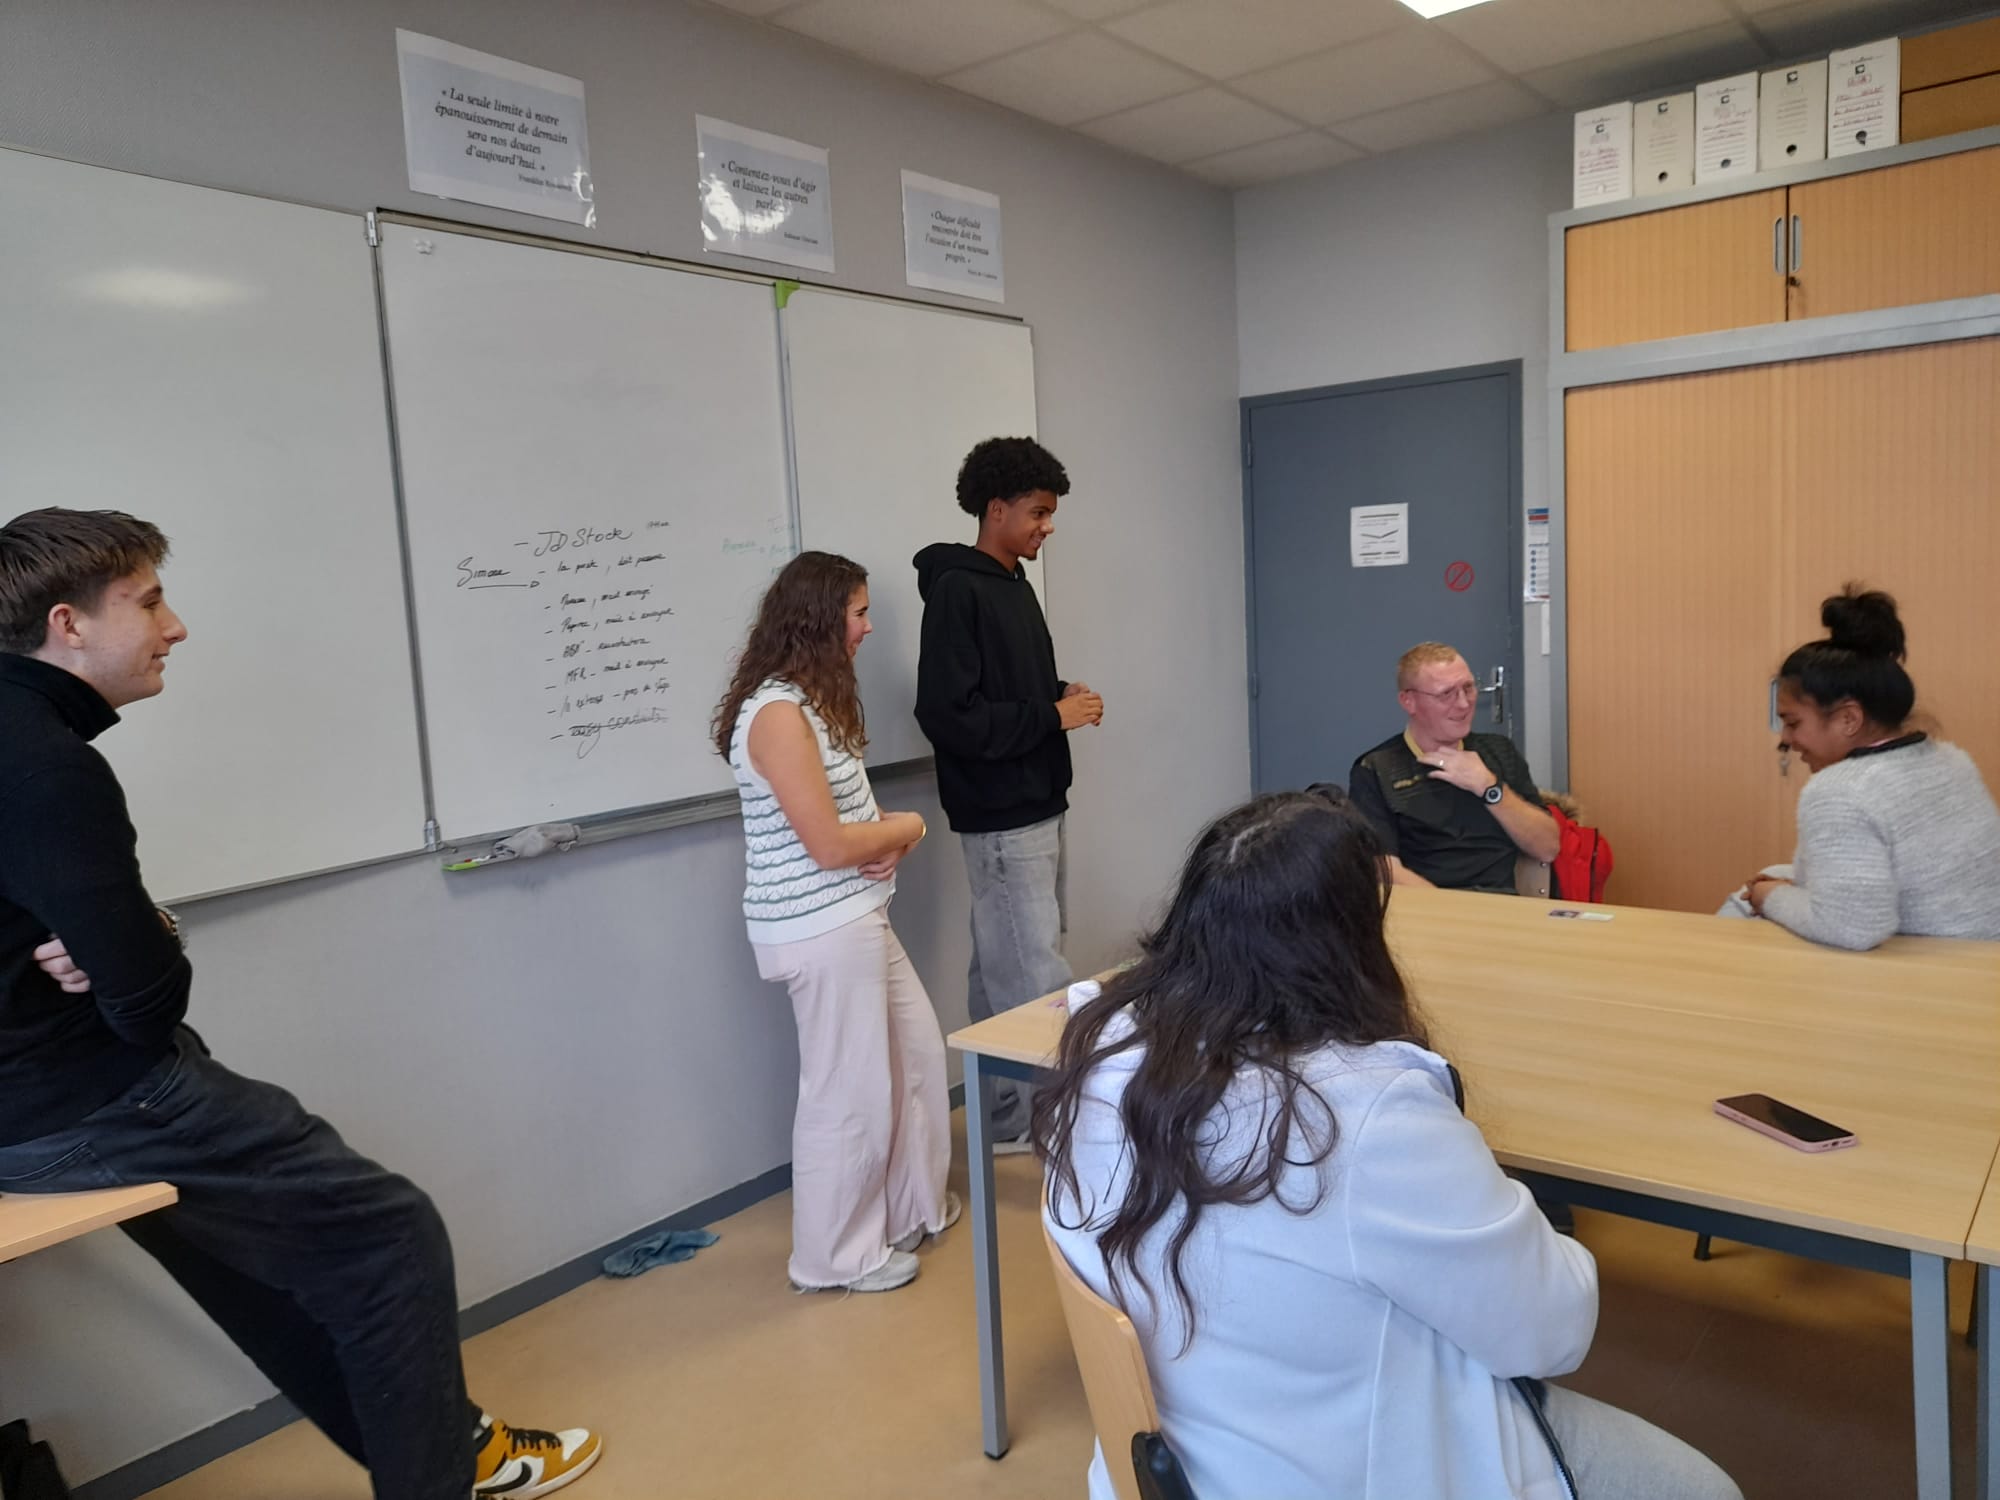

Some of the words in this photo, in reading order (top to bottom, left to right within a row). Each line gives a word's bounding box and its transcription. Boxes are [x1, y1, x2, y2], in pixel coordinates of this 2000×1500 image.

[435, 101, 515, 132] épanouissement
[518, 123, 529, 135] de
[532, 126, 568, 144] demain
[450, 87, 464, 102] La
[467, 95, 491, 109] seule
[494, 99, 523, 117] limite
[525, 107, 532, 119] à
[535, 113, 559, 126] notre
[467, 130, 487, 142] sera
[490, 135, 507, 147] nos
[510, 137, 541, 154] doutes
[732, 180, 740, 189] et
[742, 178, 769, 196] laissez
[771, 184, 782, 198] les
[783, 191, 809, 205] autres
